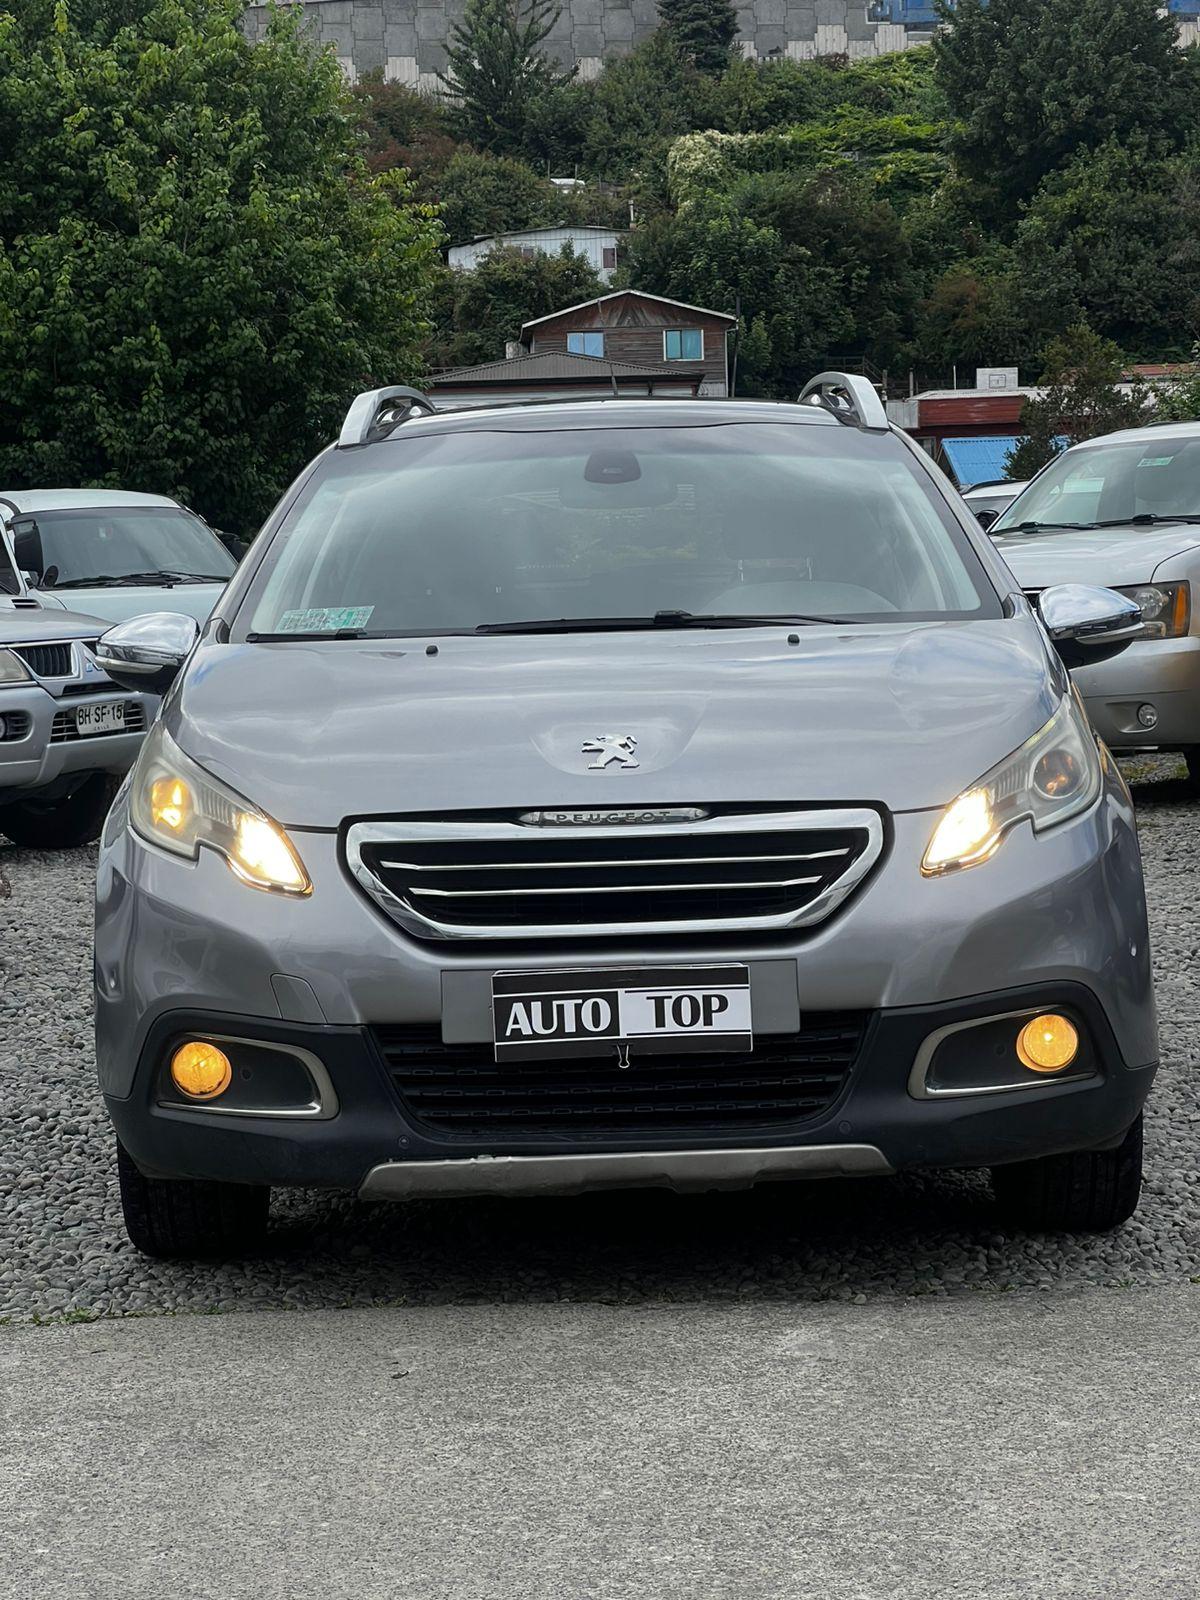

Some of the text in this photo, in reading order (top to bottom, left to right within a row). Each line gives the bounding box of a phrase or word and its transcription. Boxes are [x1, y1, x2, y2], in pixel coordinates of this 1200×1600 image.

[556, 811, 671, 824] PEUGEOT
[504, 994, 729, 1037] AUTO TOP
